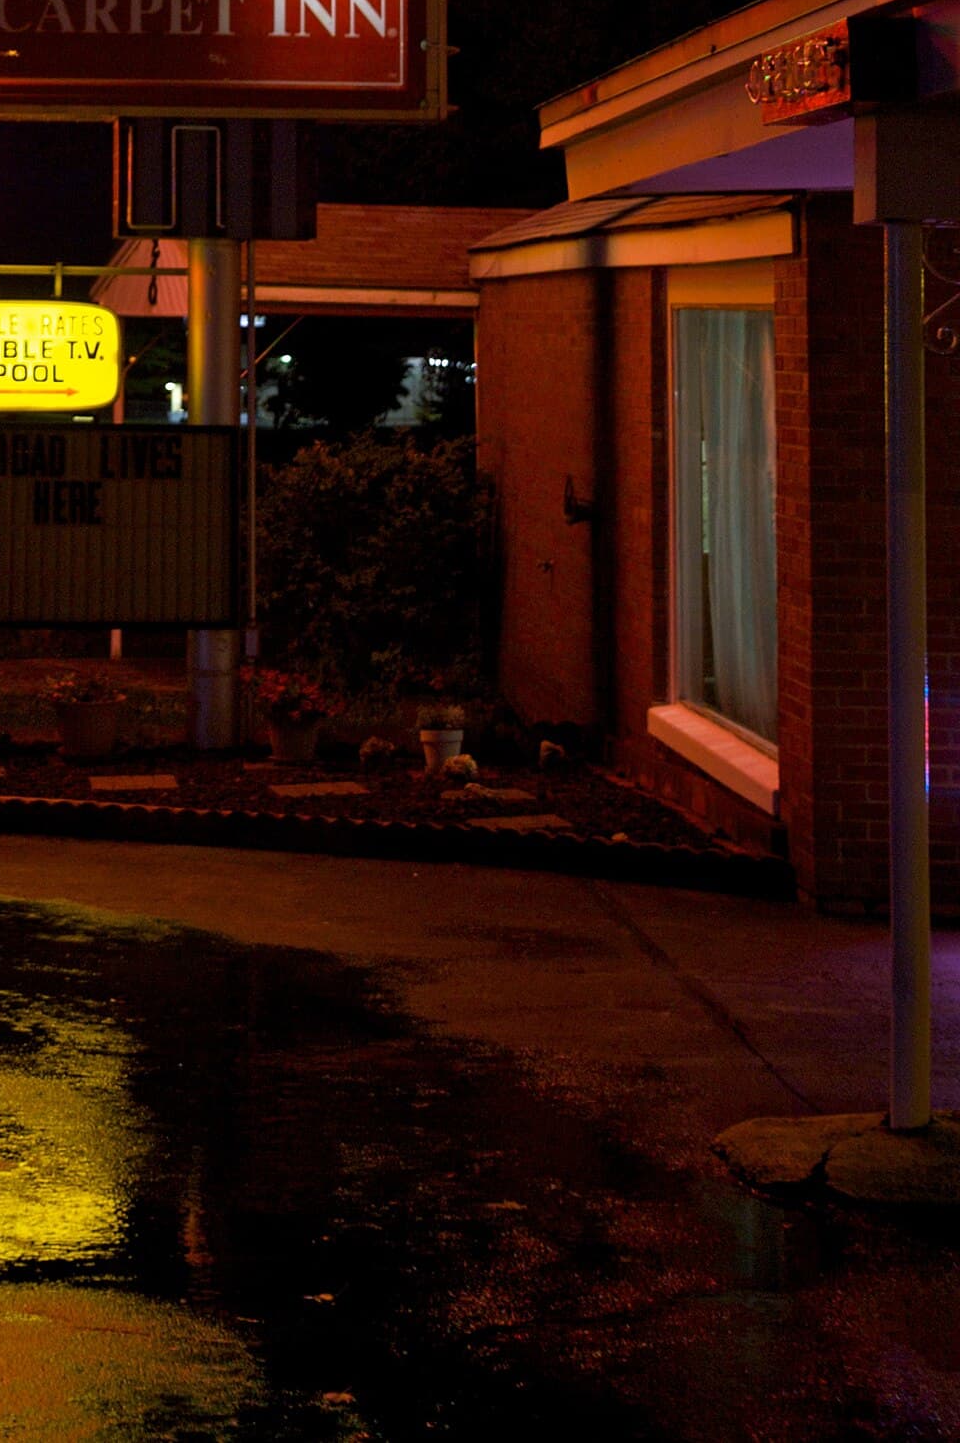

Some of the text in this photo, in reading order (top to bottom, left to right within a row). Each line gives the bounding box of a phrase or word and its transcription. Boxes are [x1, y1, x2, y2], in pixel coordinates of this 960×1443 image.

[40, 315, 105, 337] RATES
[67, 340, 105, 361] T.V.
[100, 435, 183, 479] LIVES
[34, 480, 103, 525] HERE
